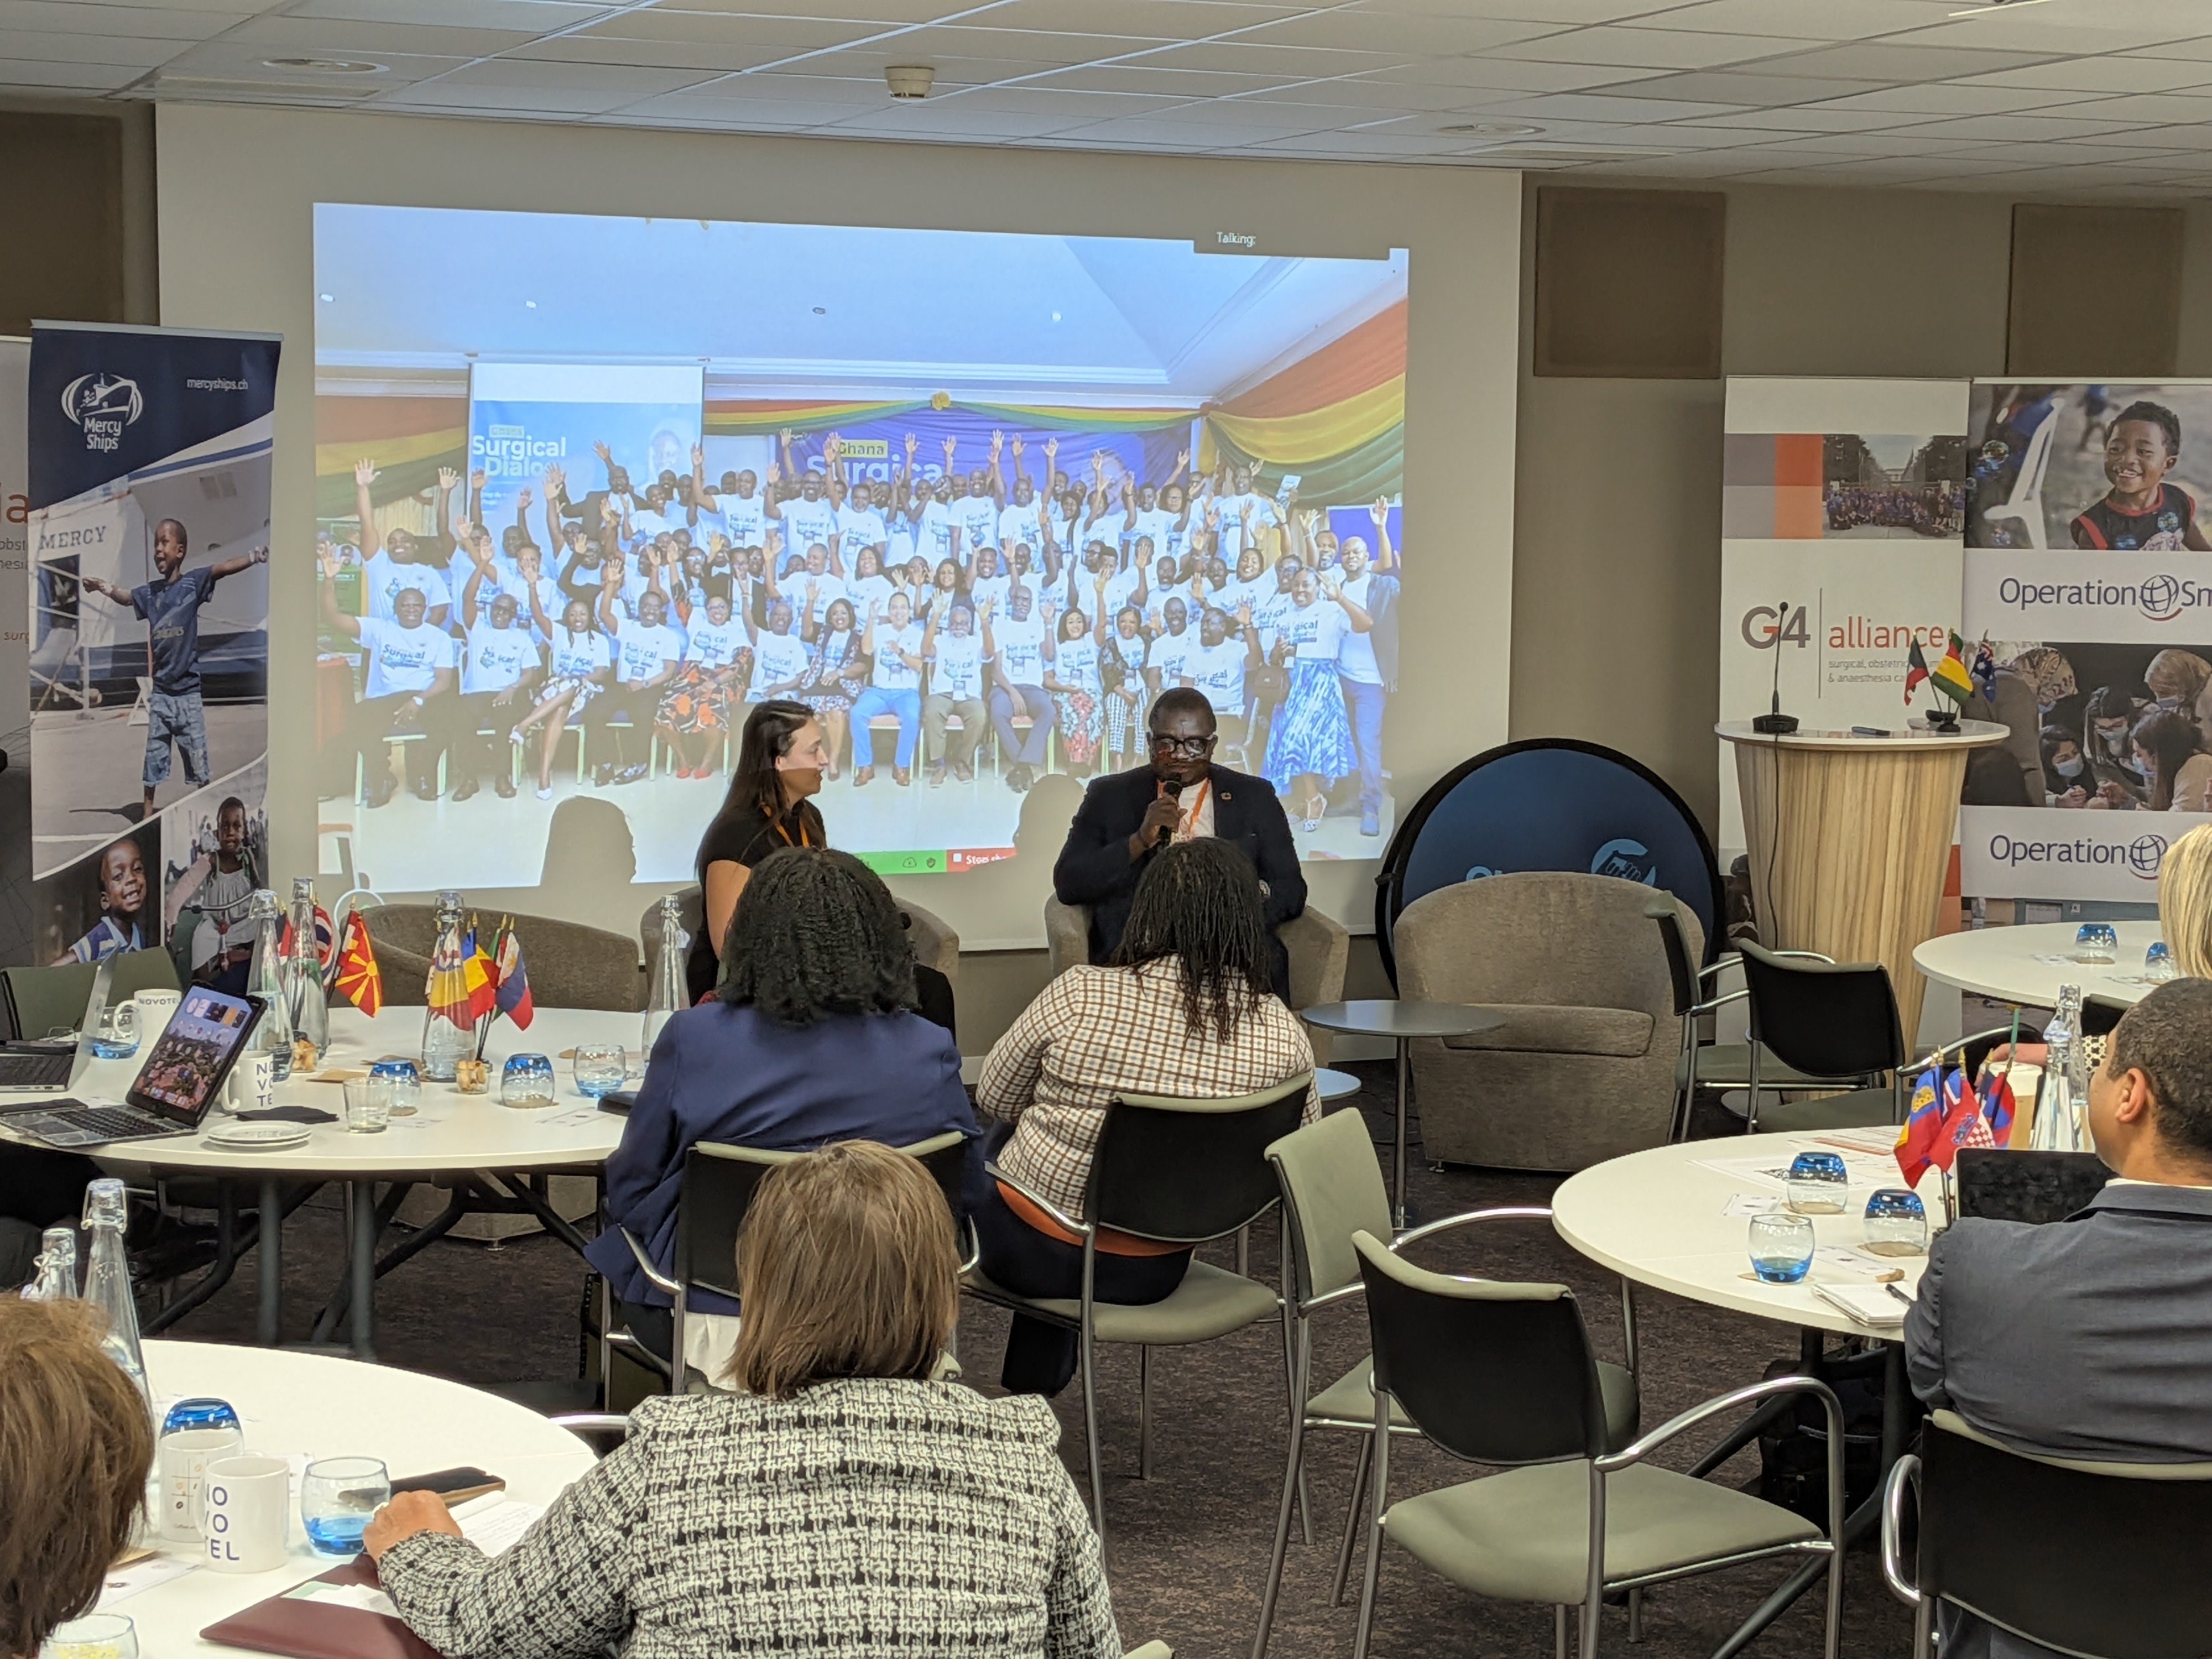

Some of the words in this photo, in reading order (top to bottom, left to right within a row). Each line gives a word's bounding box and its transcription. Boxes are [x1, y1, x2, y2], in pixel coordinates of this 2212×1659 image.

[186, 378, 248, 392] mercyships.ch
[84, 418, 122, 436] Mercy
[86, 434, 119, 453] Ships
[472, 435, 566, 460] Surgical
[838, 442, 884, 455] Ghana
[40, 526, 106, 550] MERCY
[2000, 577, 2136, 610] Operation
[1741, 606, 1811, 649] G4
[1828, 615, 1944, 649] alliance
[1828, 673, 1835, 683] &
[1991, 835, 2126, 867] Operation
